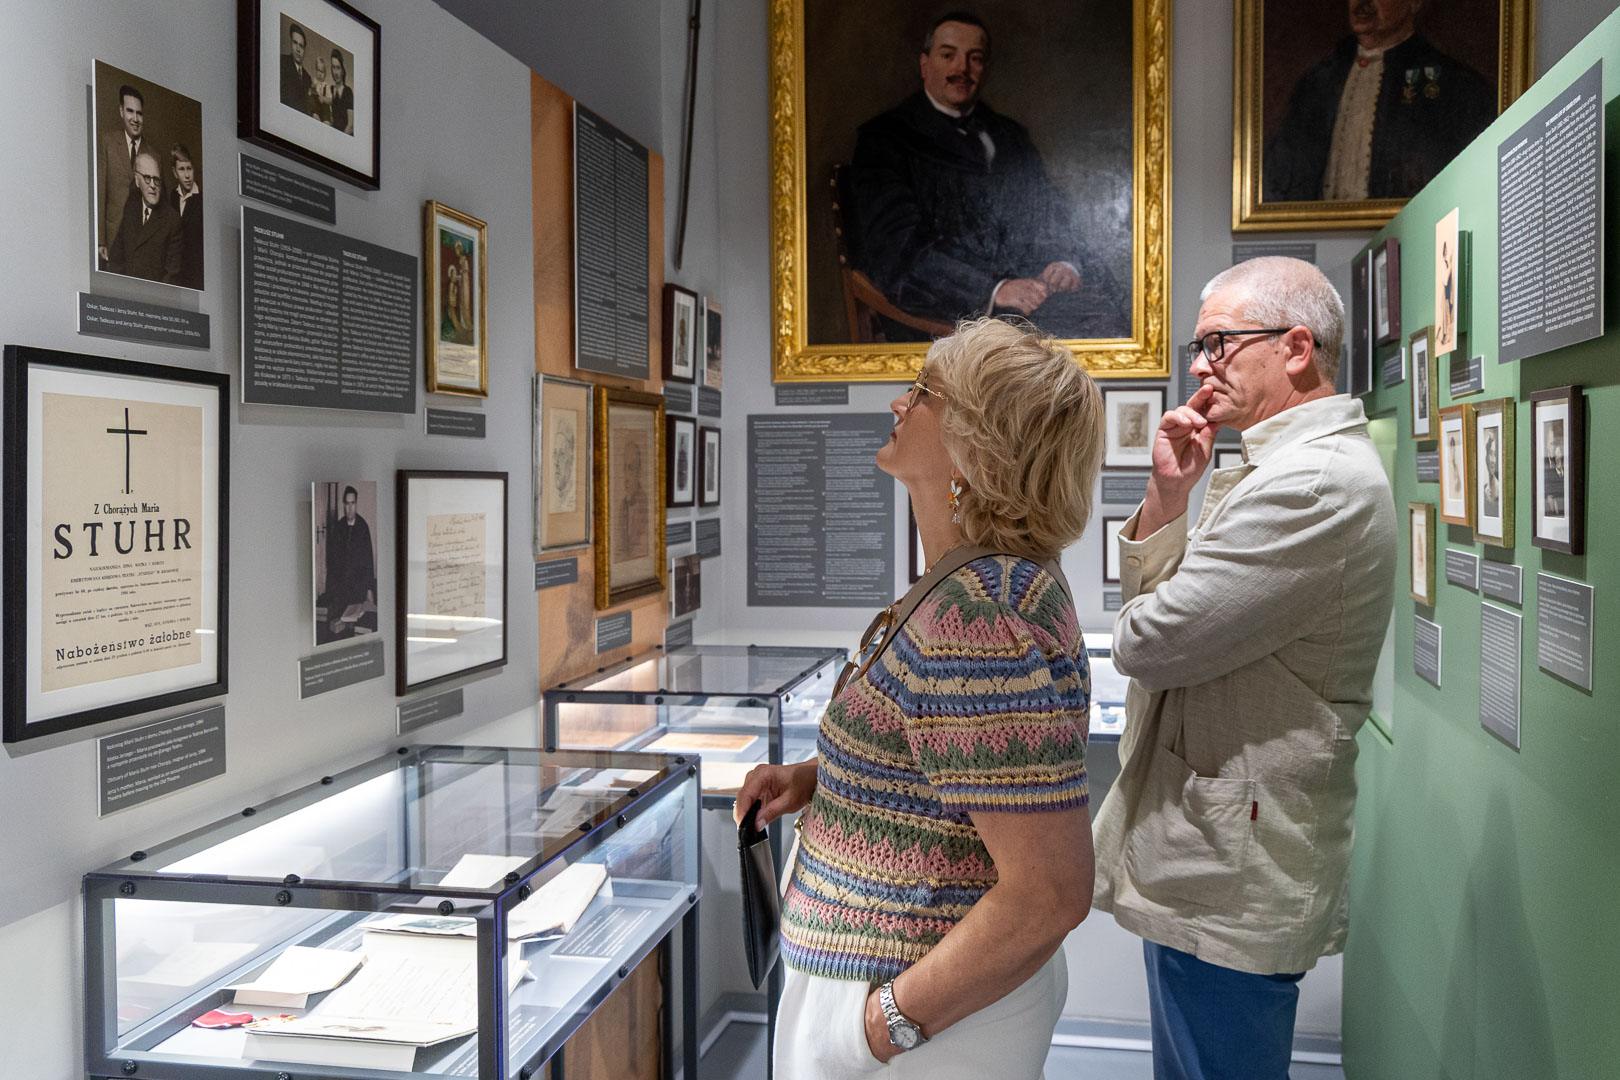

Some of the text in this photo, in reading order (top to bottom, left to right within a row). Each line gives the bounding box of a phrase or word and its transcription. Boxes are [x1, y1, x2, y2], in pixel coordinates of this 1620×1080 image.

[94, 502, 160, 516] Z Chorążych Maria
[54, 518, 192, 559] STUHR
[149, 629, 192, 645] żałobne
